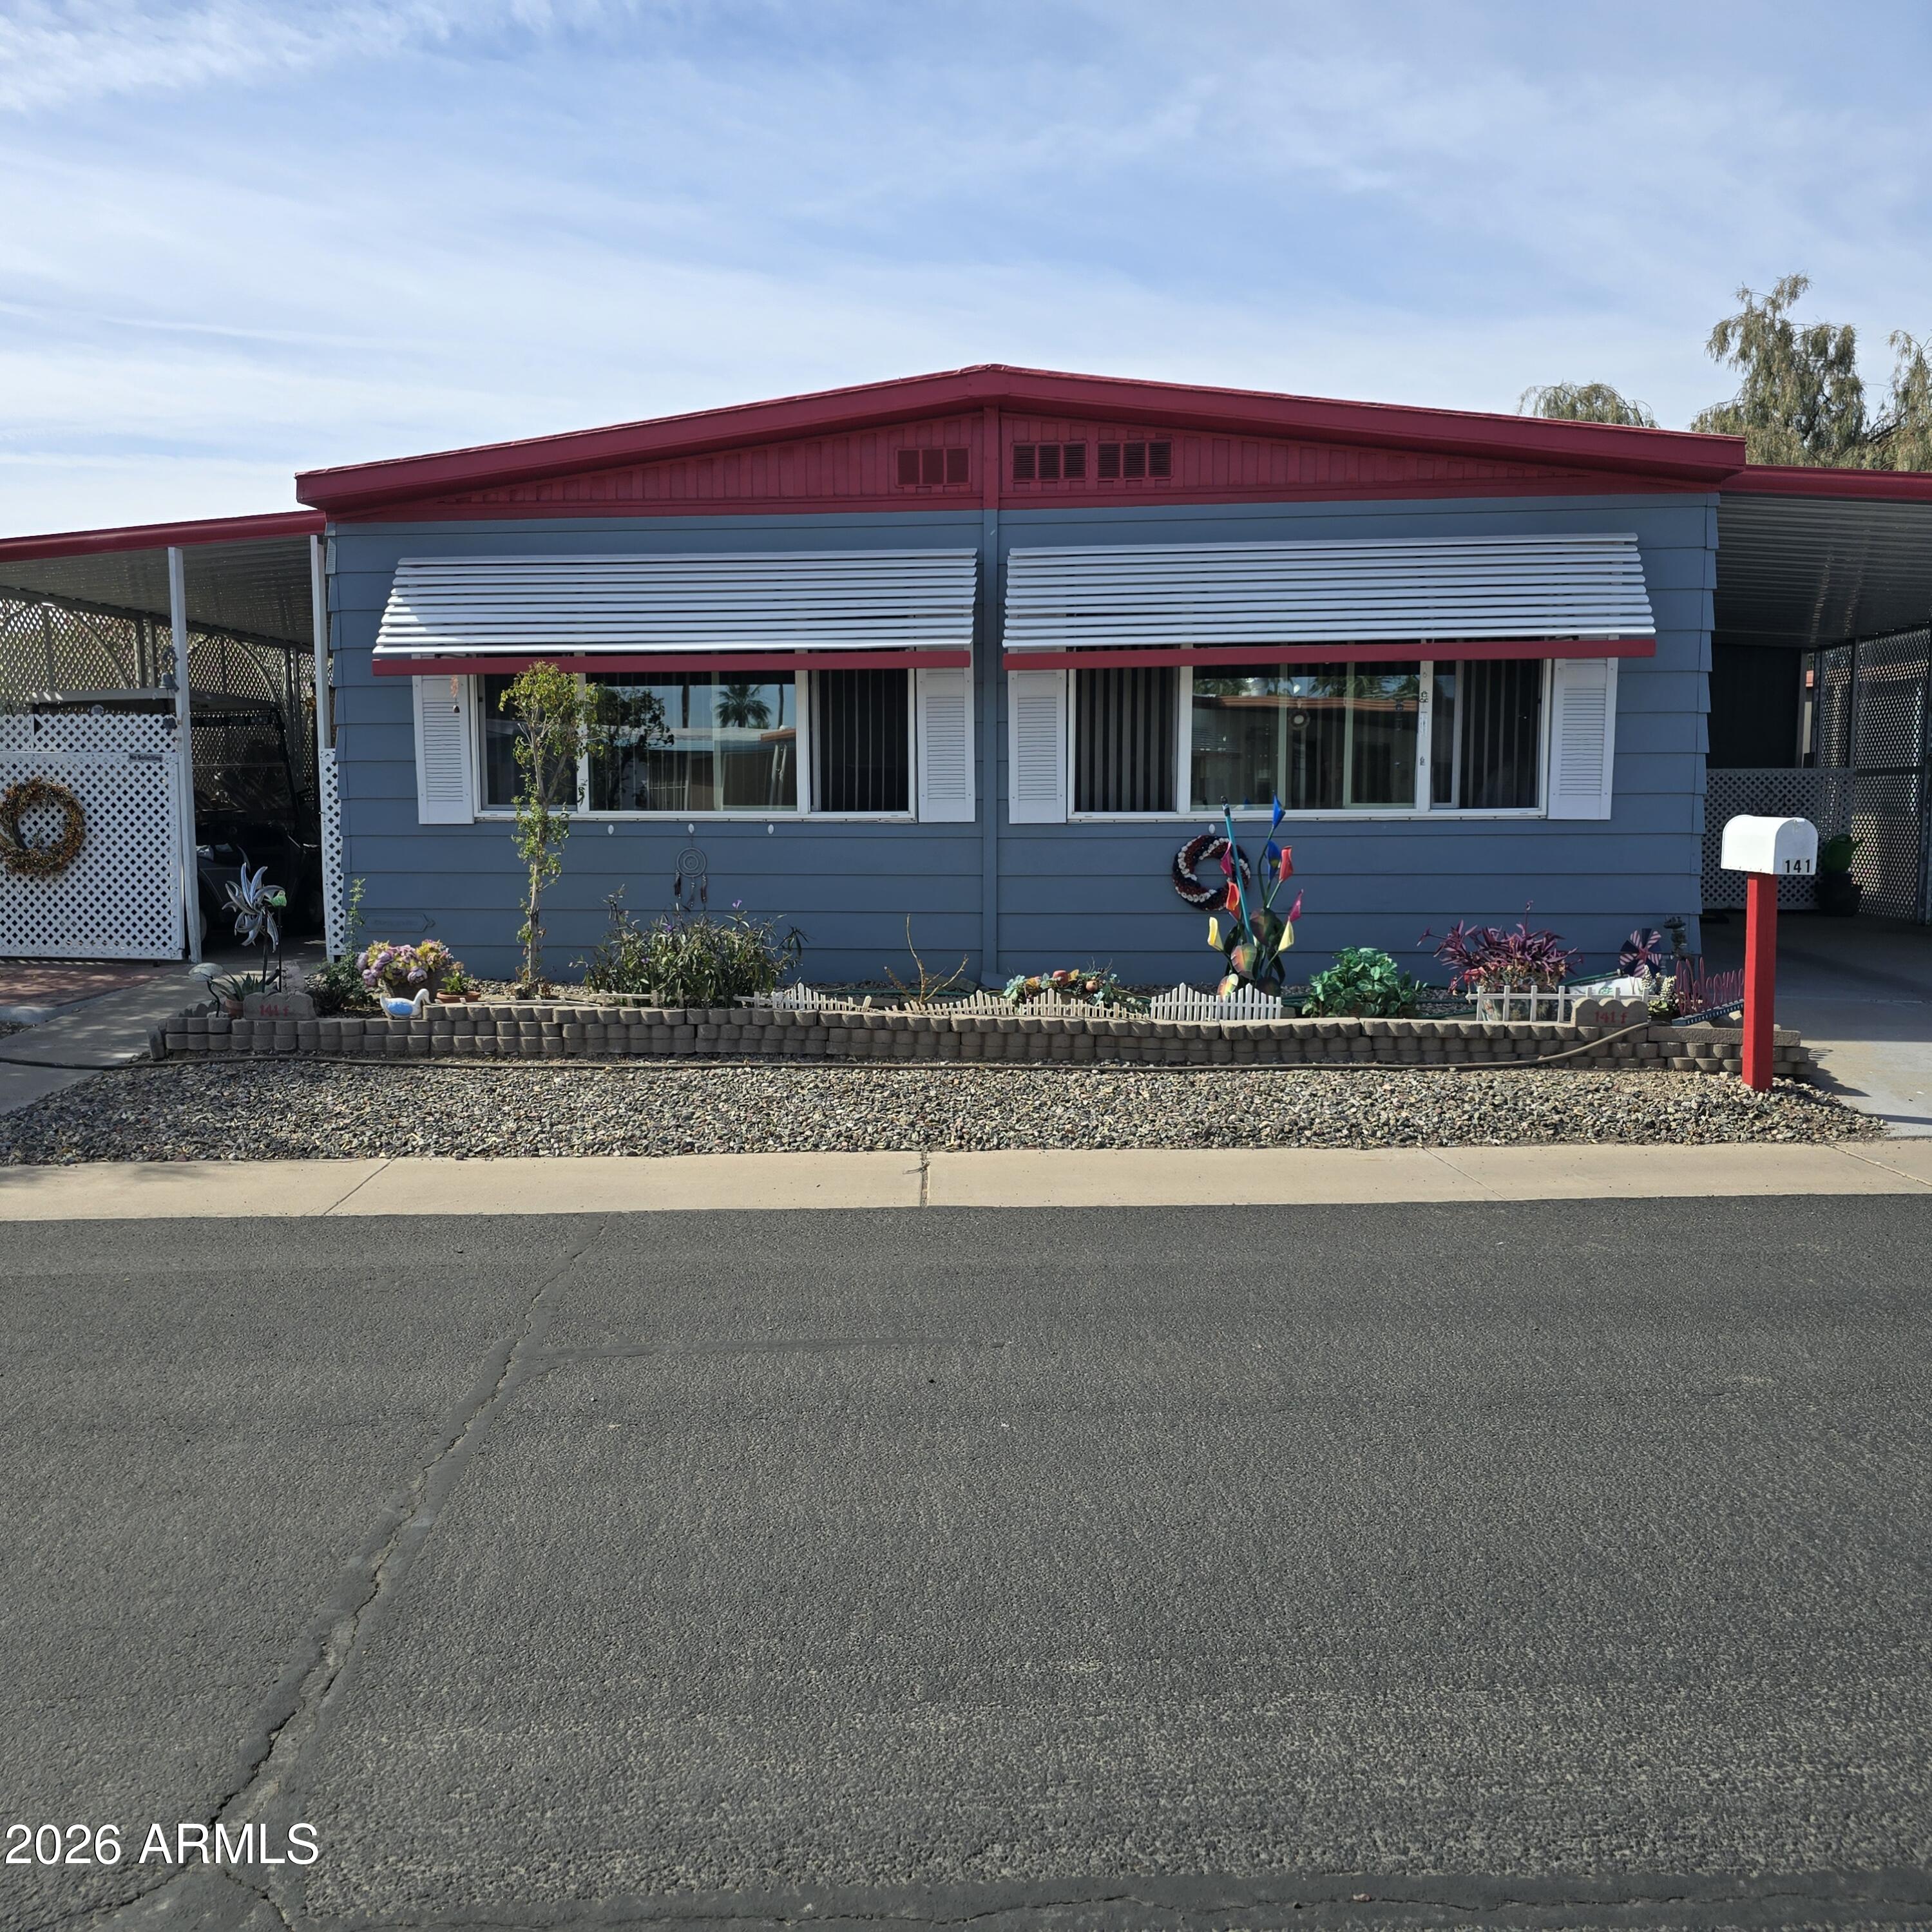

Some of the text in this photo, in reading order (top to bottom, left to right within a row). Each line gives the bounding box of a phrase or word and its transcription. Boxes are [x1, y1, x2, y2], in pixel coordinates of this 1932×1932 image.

[1785, 859, 1811, 873] 141
[260, 1004, 279, 1016] 141
[1594, 1011, 1616, 1023] 141
